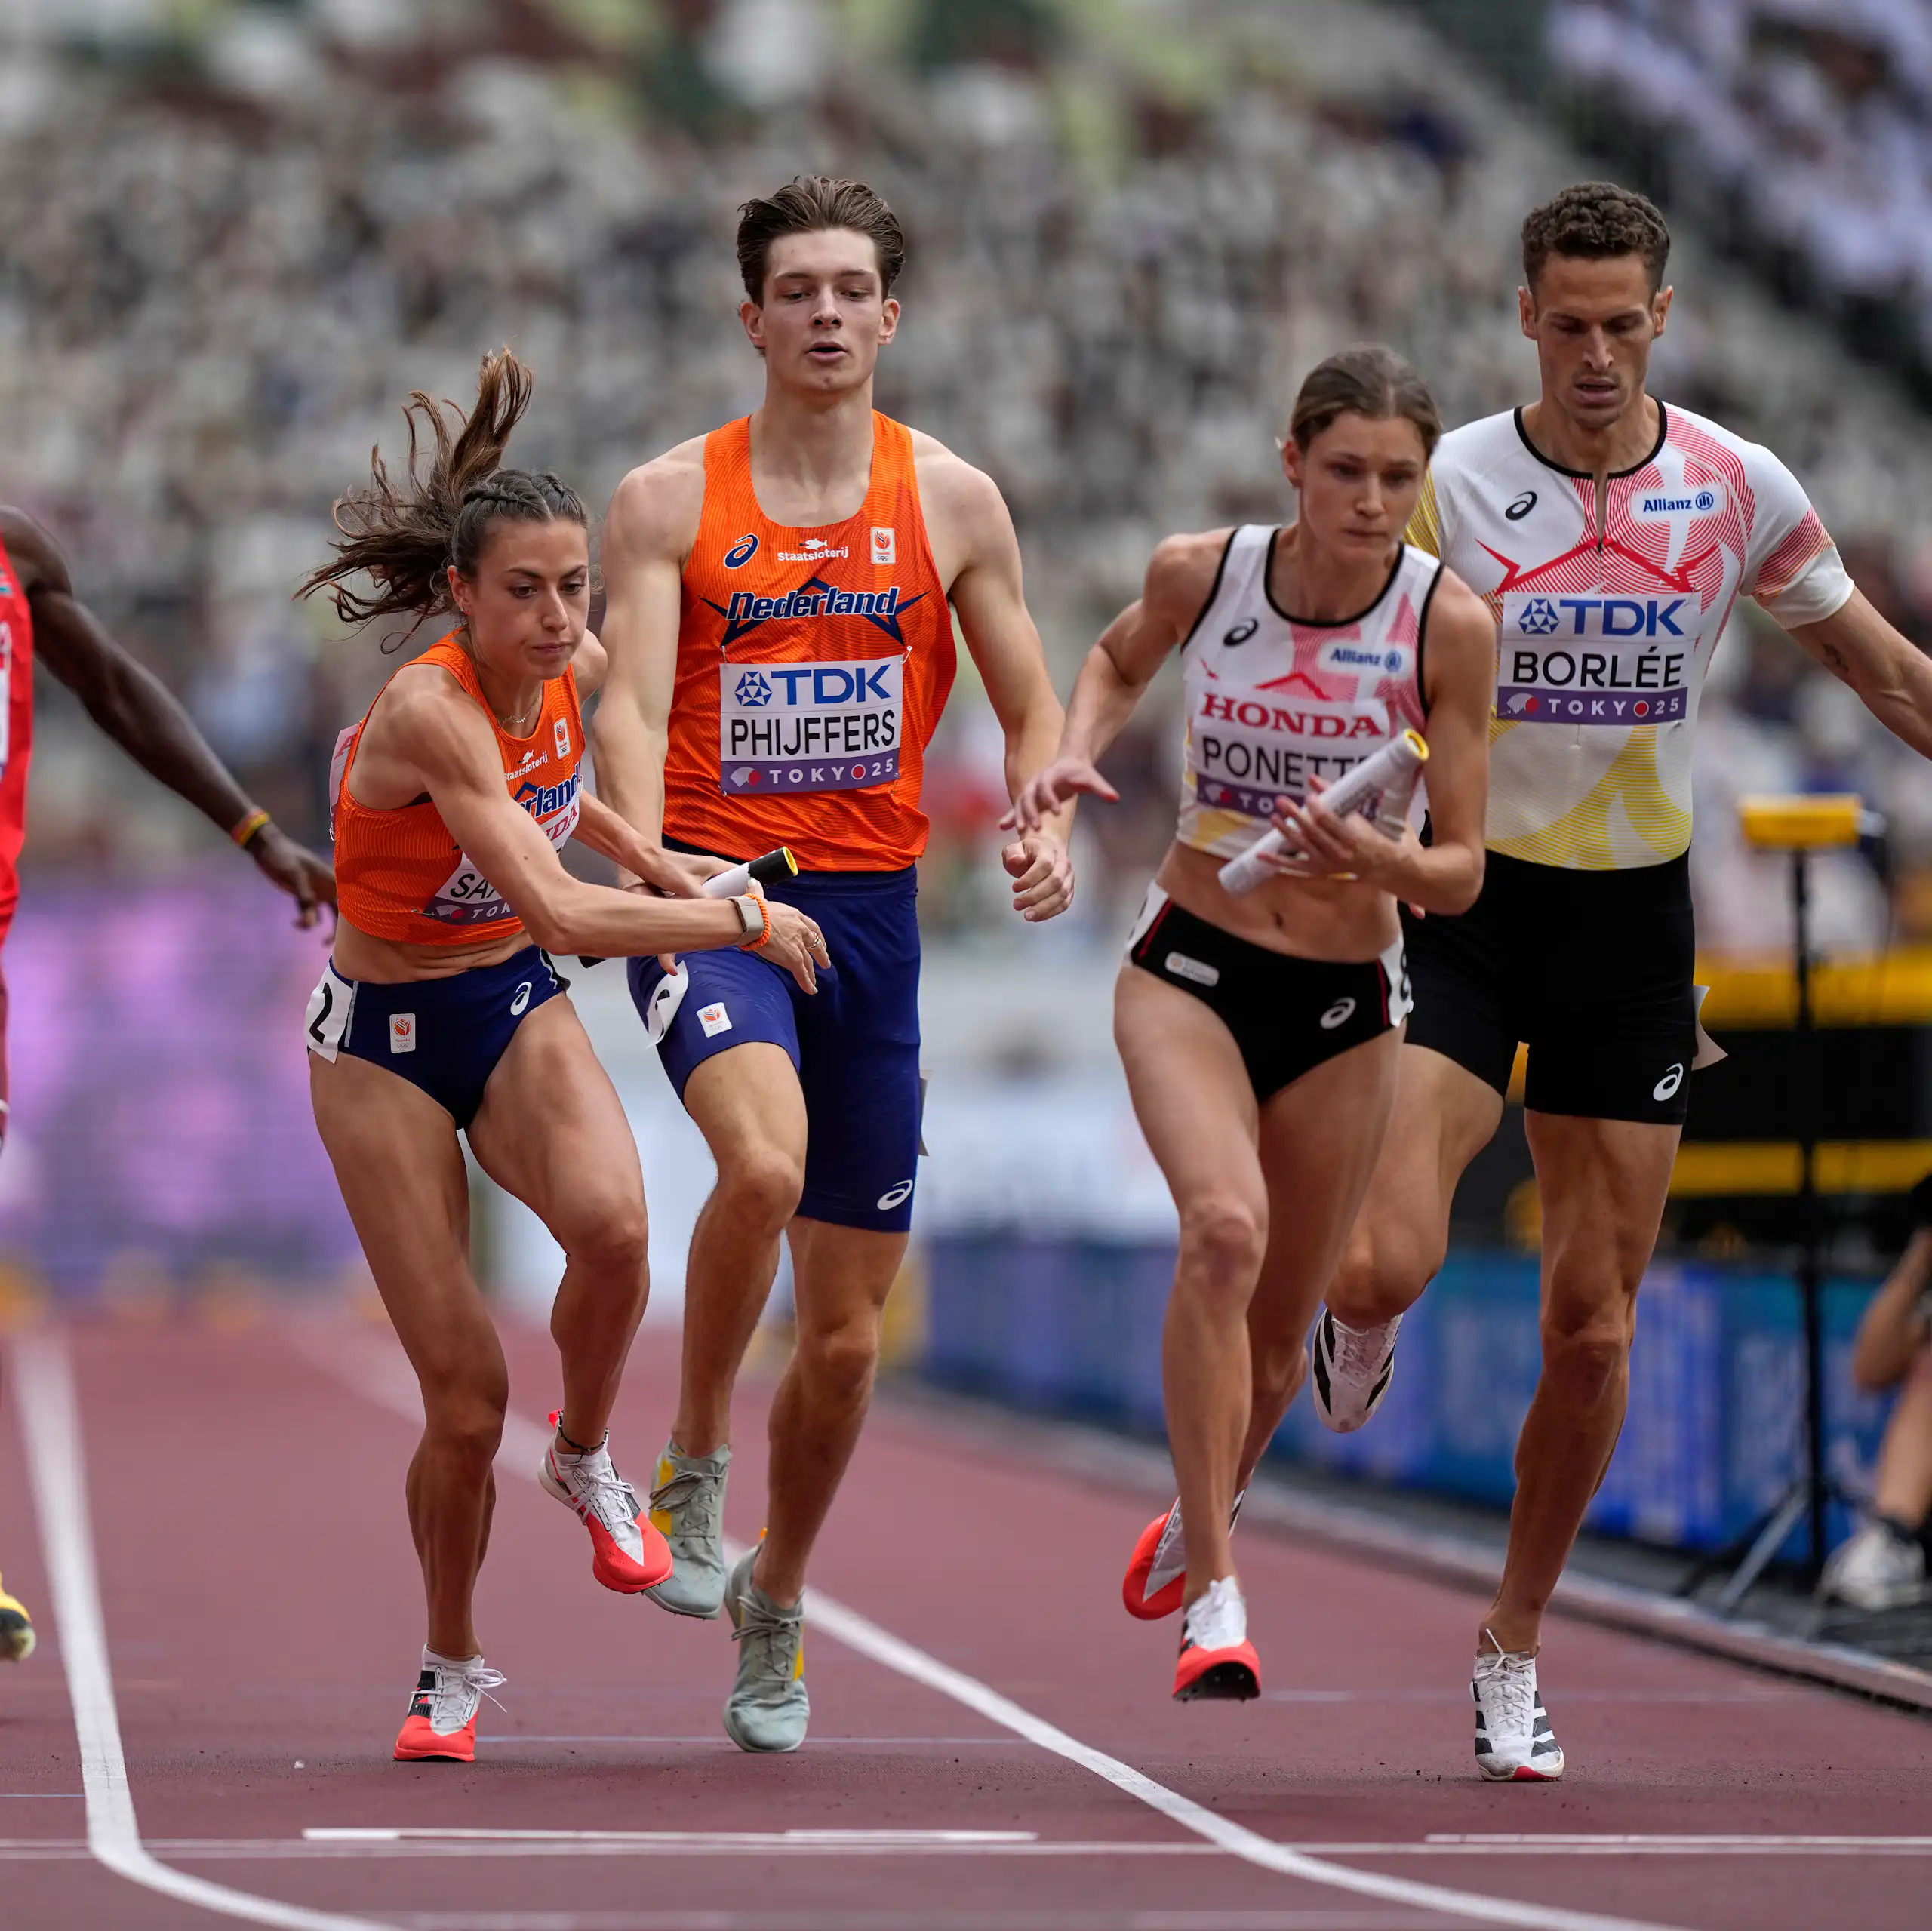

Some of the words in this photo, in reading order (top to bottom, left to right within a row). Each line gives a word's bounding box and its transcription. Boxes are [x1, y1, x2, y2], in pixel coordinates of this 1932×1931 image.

[1644, 498, 1692, 512] Allianz
[777, 546, 849, 561] Staatsloterij
[1559, 599, 1686, 636] TDK
[1330, 647, 1381, 666] Allianz
[1512, 646, 1684, 688] BORLÉE
[771, 664, 891, 705] TDK
[731, 709, 895, 755] PHIJFFERS
[1200, 692, 1385, 739] HONDA
[1202, 735, 1369, 789] PONETT
[1237, 792, 1275, 813] TO
[309, 982, 333, 1044] 2
